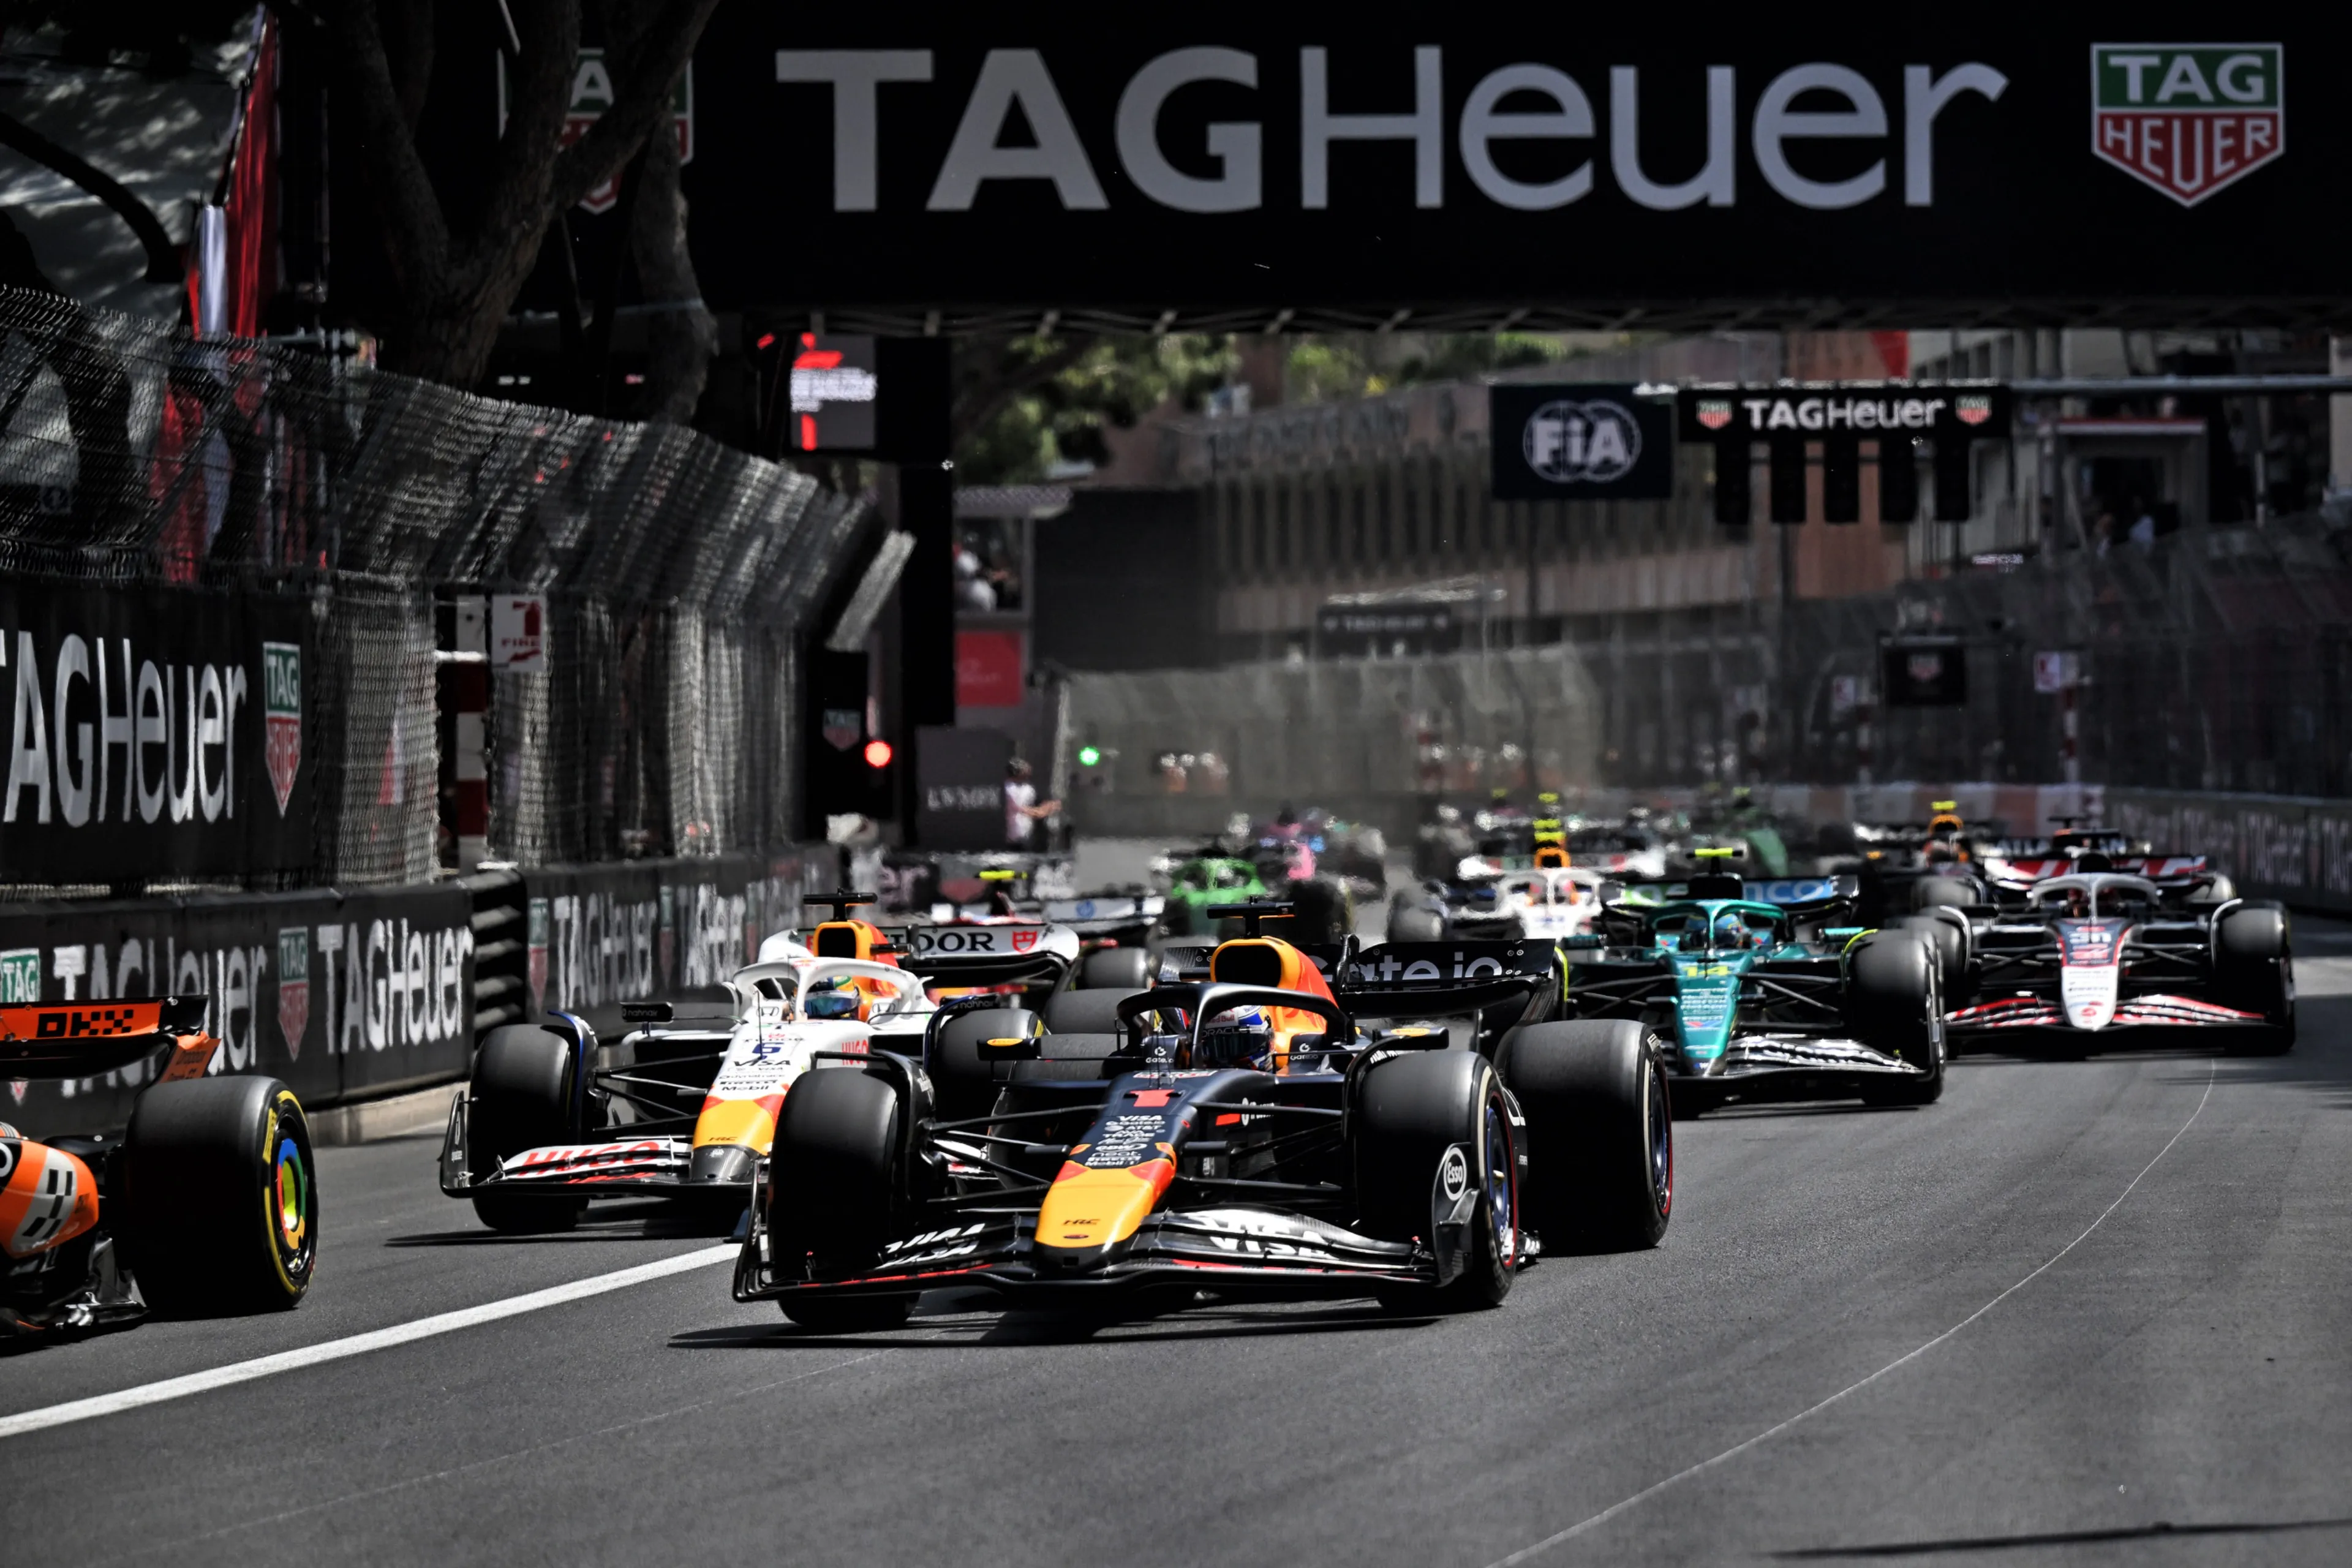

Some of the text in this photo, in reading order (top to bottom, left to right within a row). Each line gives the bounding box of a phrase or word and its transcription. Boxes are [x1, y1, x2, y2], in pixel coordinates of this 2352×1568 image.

[2108, 54, 2266, 103] TAG
[2105, 118, 2273, 193] HEUER
[268, 655, 298, 707] TAG
[280, 937, 306, 977] TAG
[1683, 965, 1732, 977] 14
[36, 1009, 134, 1038] OKX
[752, 1042, 785, 1055] 6
[1129, 1088, 1175, 1107] 1
[1447, 1162, 1463, 1184] Esso
